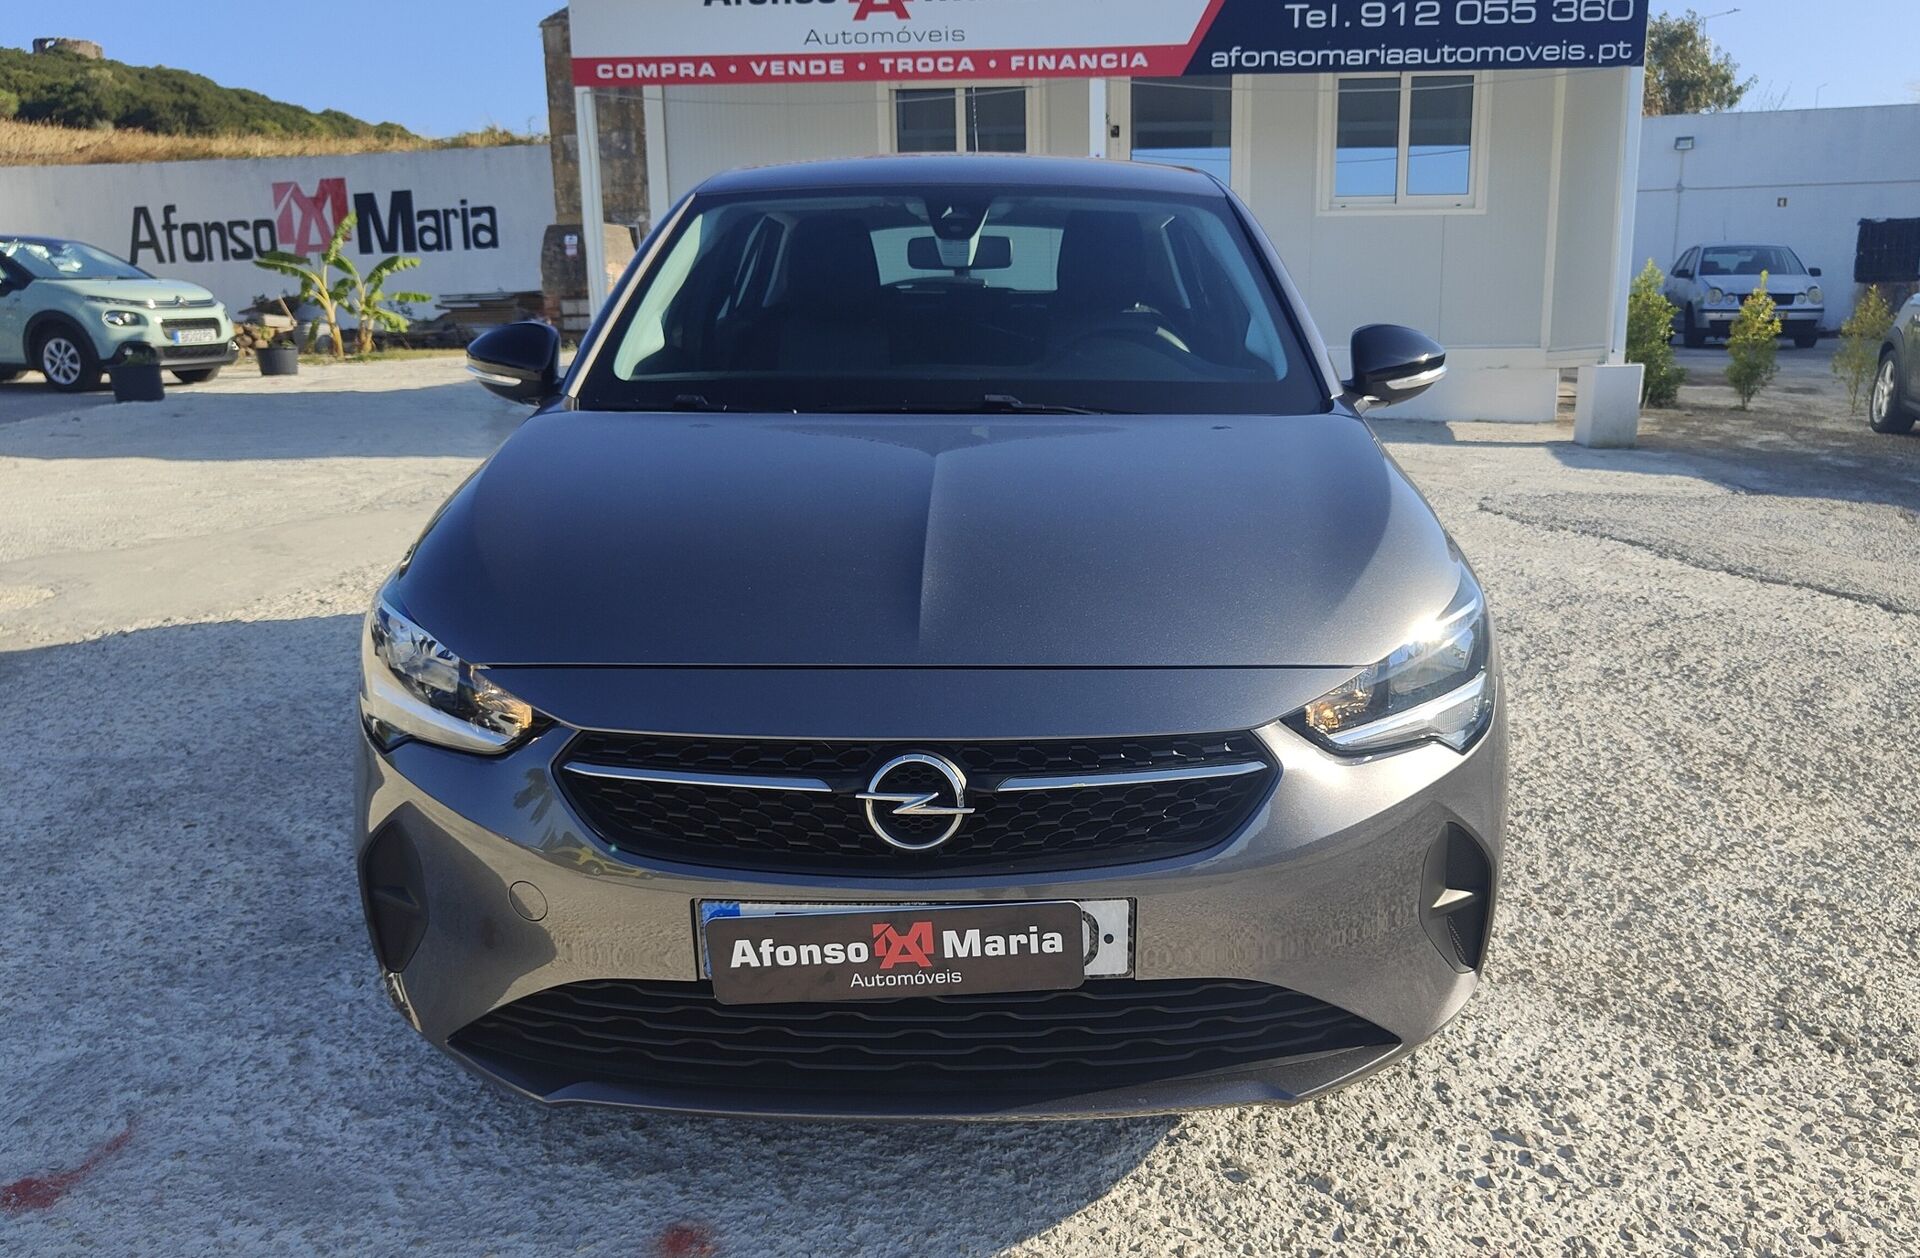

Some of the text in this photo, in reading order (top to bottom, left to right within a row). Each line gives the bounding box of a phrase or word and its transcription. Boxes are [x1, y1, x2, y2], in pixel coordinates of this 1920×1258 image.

[1284, 0, 1635, 28] Tel. 912 055 360
[803, 26, 966, 46] Automóveis
[597, 51, 1149, 80] COMPRA VENDE TROCA FINANCIA
[1210, 39, 1633, 69] afonsomariaautomoveis.pt
[130, 203, 278, 265] Afonso
[353, 189, 499, 255] Maria
[730, 937, 869, 968] Afonso
[942, 925, 1064, 960] Maria
[850, 969, 962, 988] Automóveis
